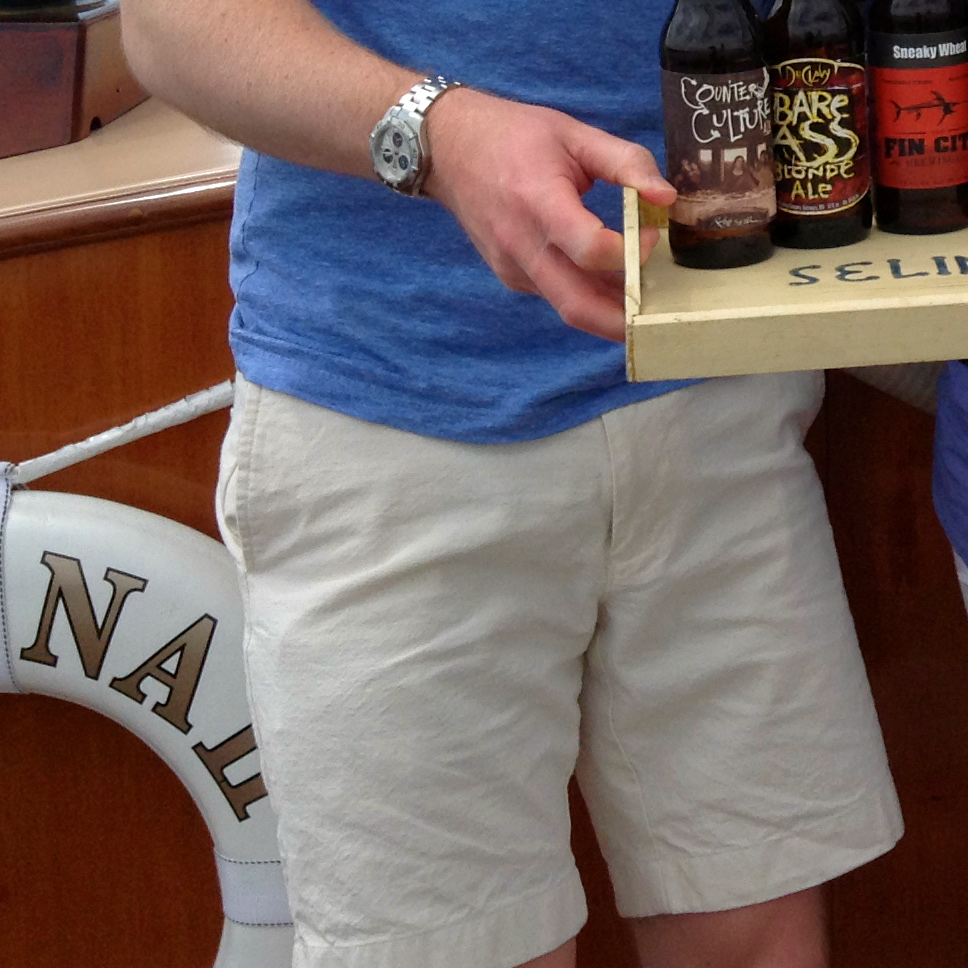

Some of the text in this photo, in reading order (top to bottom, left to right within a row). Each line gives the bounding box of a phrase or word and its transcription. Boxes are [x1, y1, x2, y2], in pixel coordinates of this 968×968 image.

[893, 40, 967, 59] Sneaky Wheat
[692, 98, 770, 143] CULTURE
[774, 119, 860, 169] ASS
[884, 137, 925, 159] FIN
